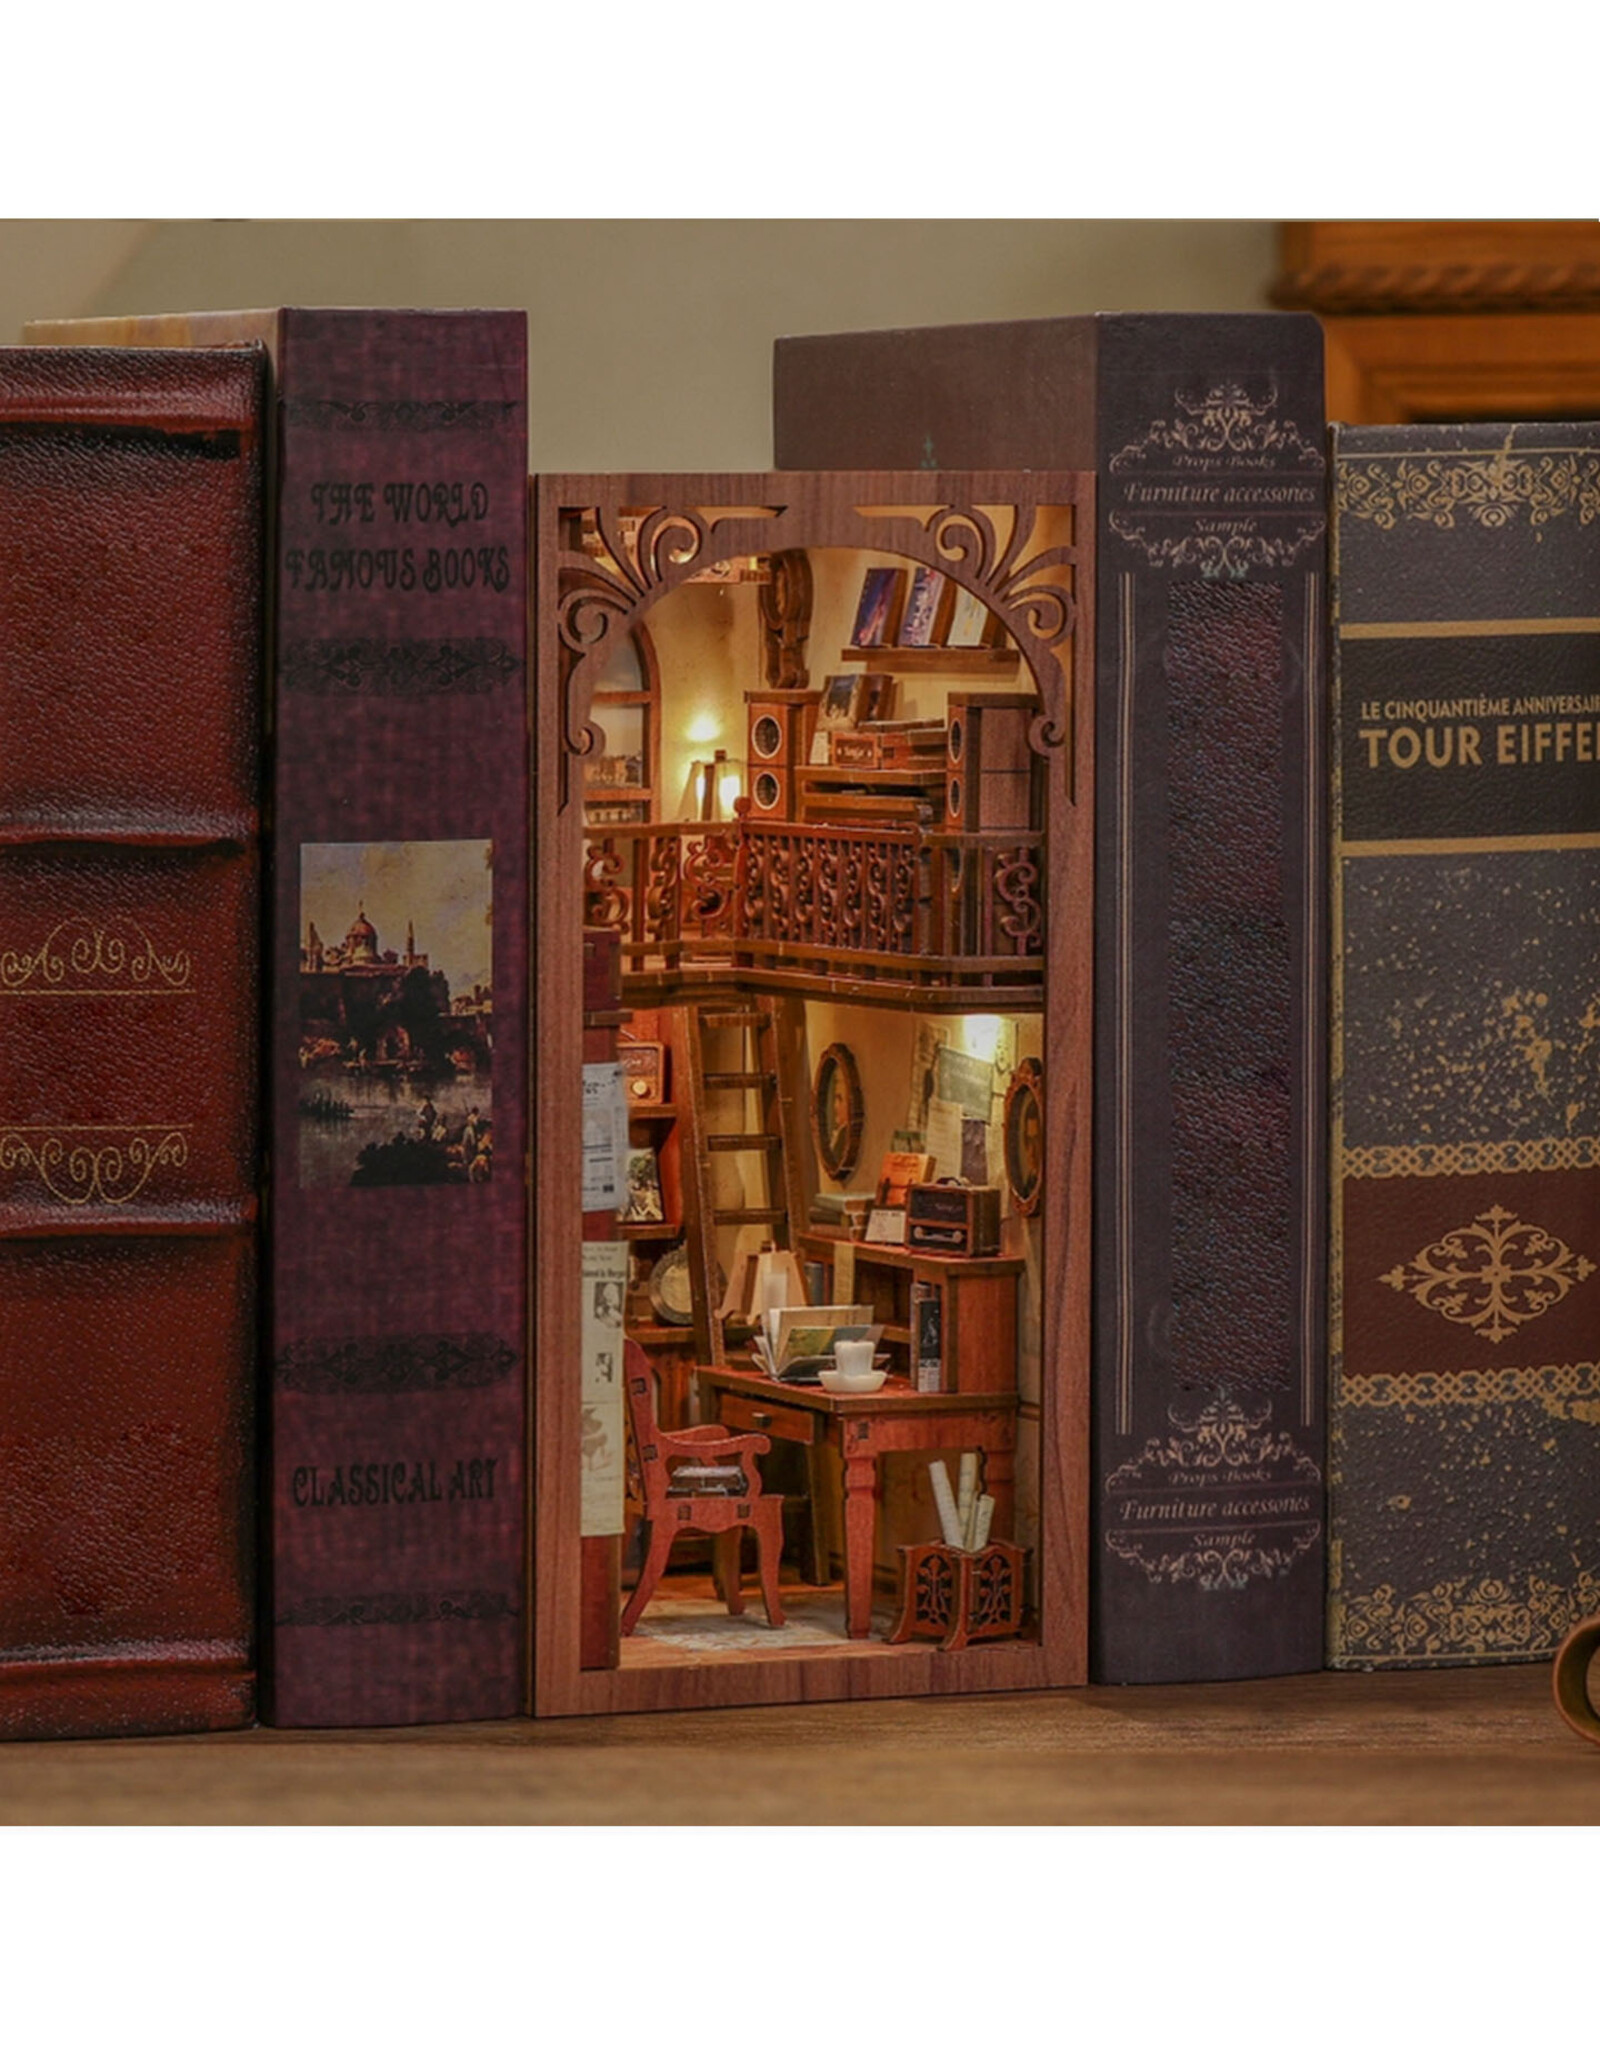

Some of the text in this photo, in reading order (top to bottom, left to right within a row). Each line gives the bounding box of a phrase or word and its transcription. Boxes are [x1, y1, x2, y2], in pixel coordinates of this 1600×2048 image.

[310, 482, 488, 526] THE WORLD
[1124, 482, 1317, 502] Furniture accessories
[1193, 518, 1257, 535] Sample
[285, 546, 510, 592] FAMOUS BOOKS
[1361, 702, 1380, 720] LE
[1384, 693, 1510, 722] CINQUANTIÈME
[1358, 726, 1483, 769] TOUR
[293, 1458, 498, 1507] CLASSICAL ART
[1120, 1496, 1310, 1521] Furniture accessories
[1190, 1531, 1256, 1549] Sample
